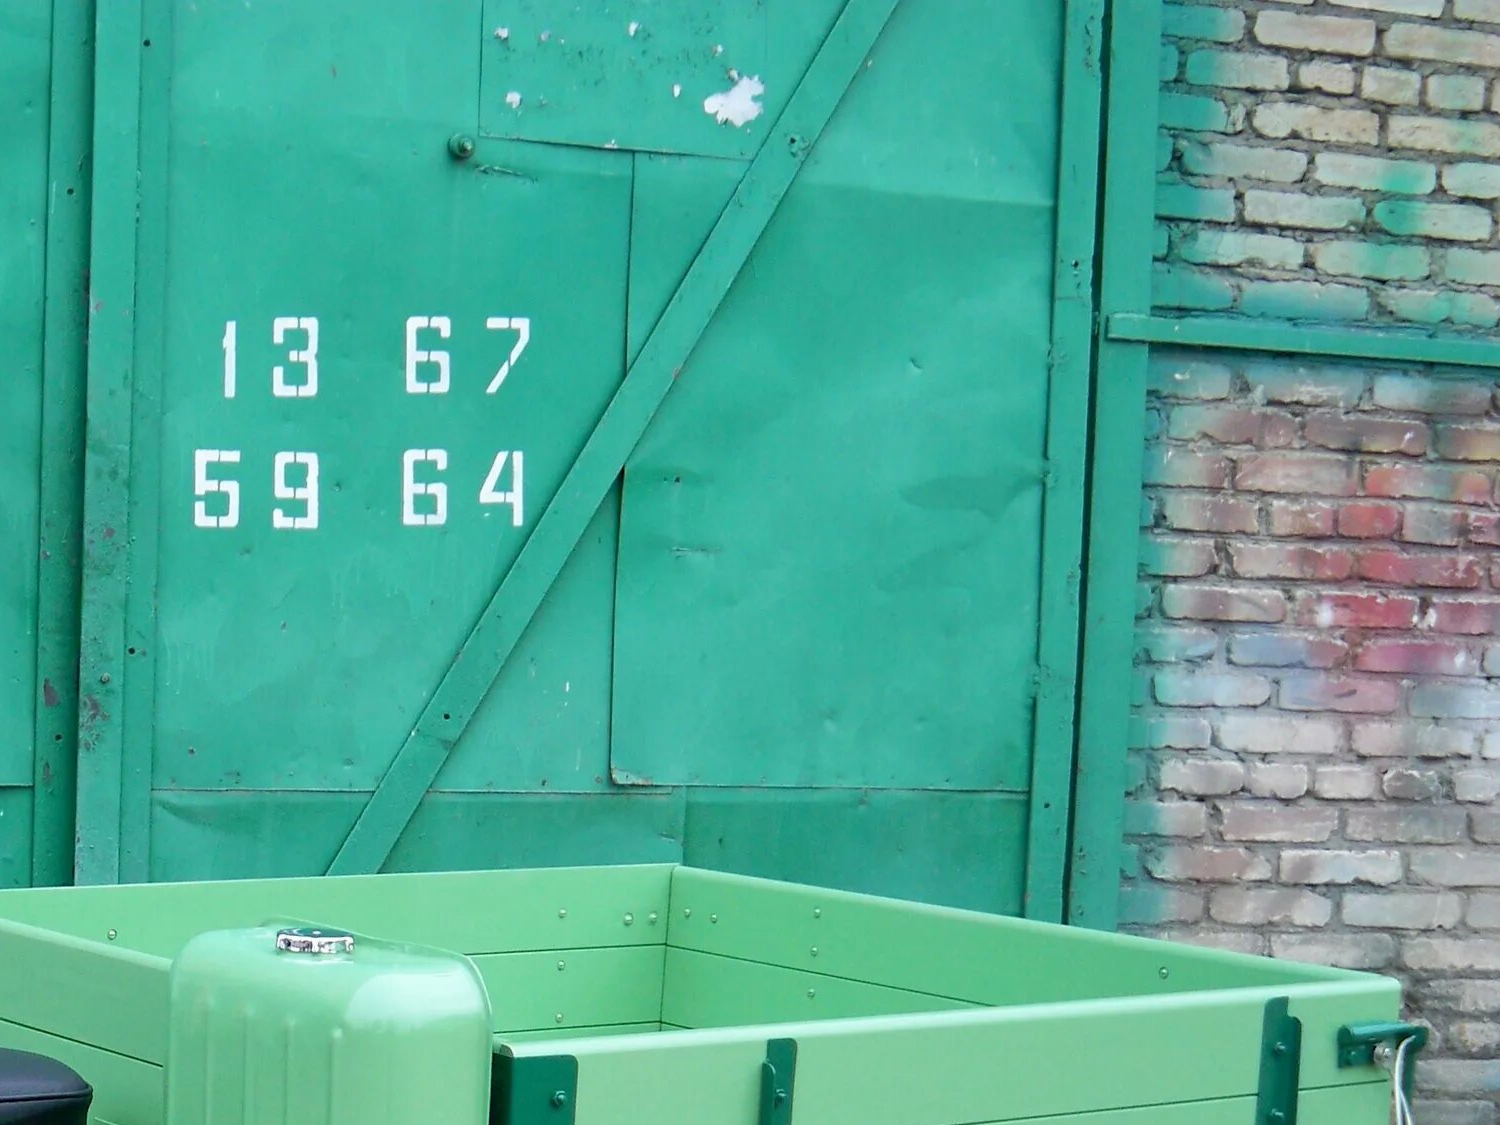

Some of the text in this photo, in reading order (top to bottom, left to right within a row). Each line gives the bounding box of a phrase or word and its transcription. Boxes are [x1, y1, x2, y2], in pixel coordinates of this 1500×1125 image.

[221, 315, 531, 399] 13 67
[193, 447, 525, 529] 59 64
